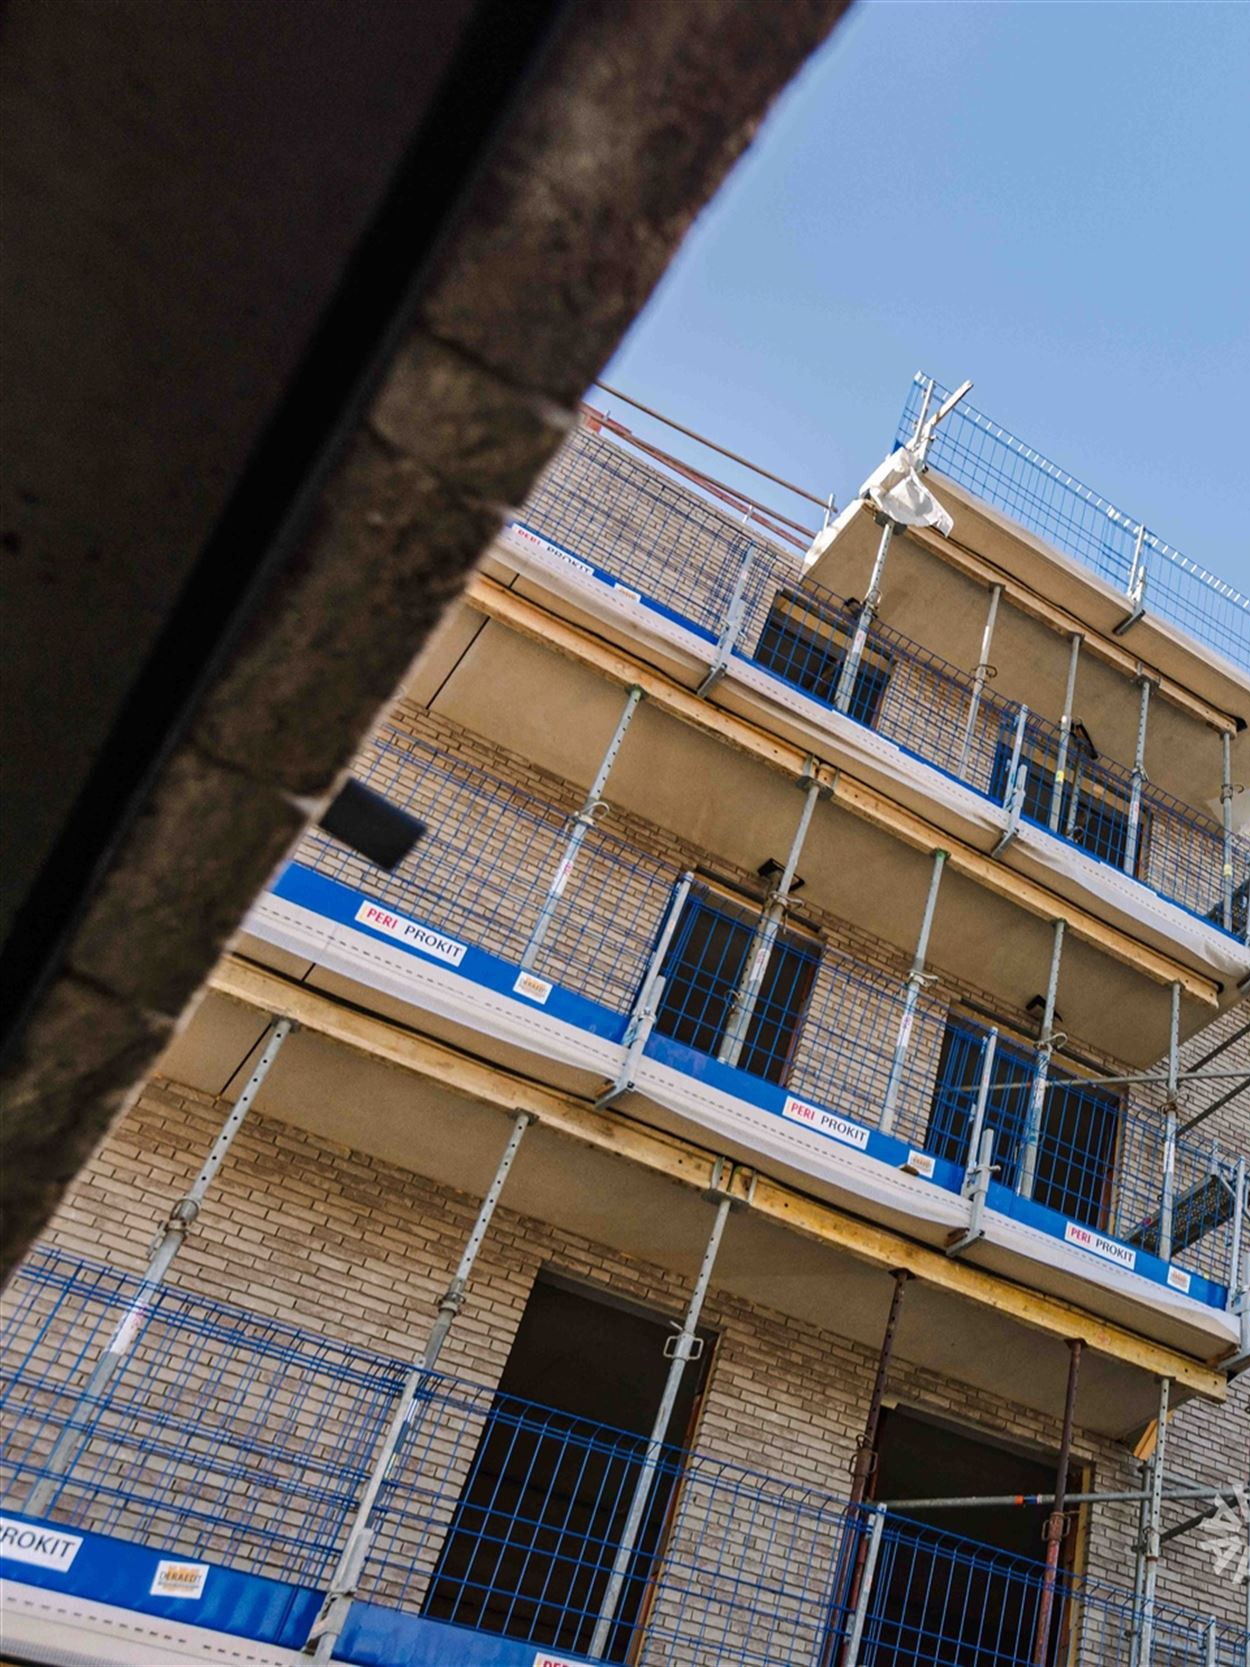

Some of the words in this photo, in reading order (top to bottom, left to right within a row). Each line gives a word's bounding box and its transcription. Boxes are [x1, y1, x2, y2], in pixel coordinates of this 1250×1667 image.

[366, 907, 399, 930] PERI
[404, 924, 463, 957] PROKIT
[790, 1102, 816, 1121] PERI
[820, 1114, 867, 1142] PROKIT
[1070, 1226, 1092, 1244] PERI
[1095, 1237, 1134, 1263] PROKIT
[0, 1525, 75, 1557] ROKIT
